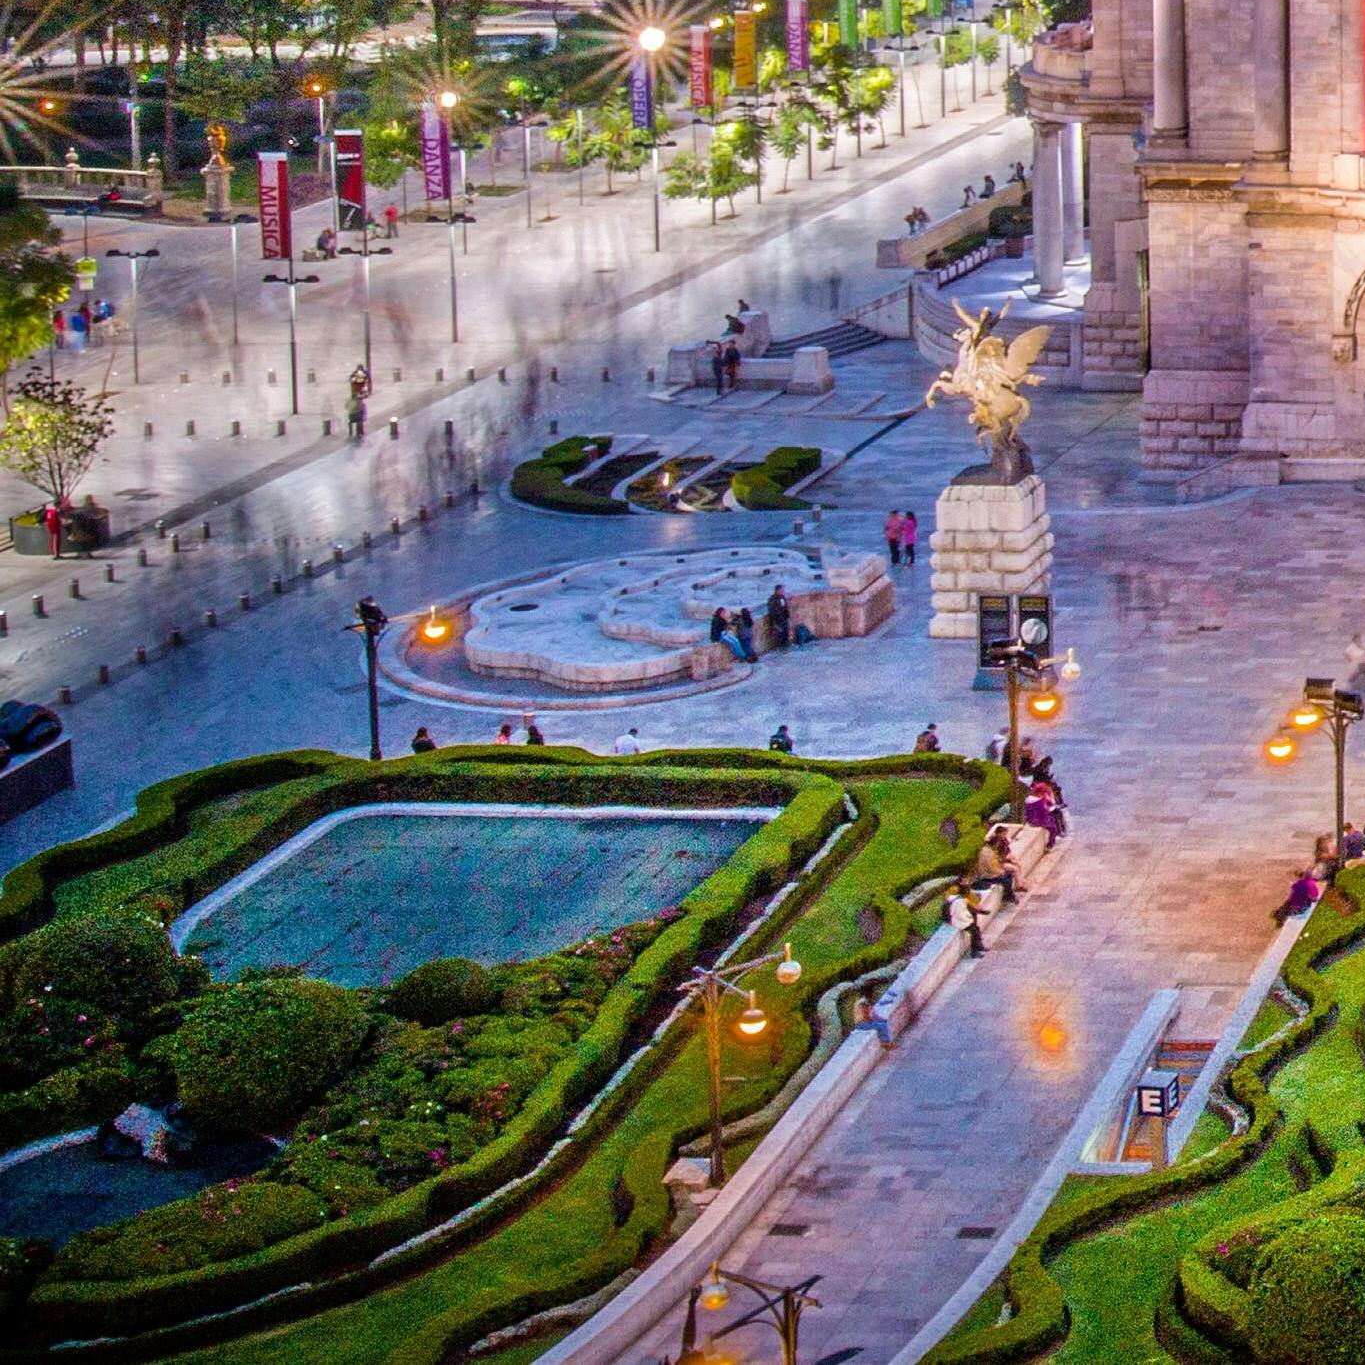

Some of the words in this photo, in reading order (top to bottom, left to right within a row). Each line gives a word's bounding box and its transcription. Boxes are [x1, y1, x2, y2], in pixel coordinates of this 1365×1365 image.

[788, 22, 802, 71] DANZA
[422, 137, 442, 200] DANZA
[260, 185, 280, 258] MUSICA
[1141, 1090, 1162, 1113] E
